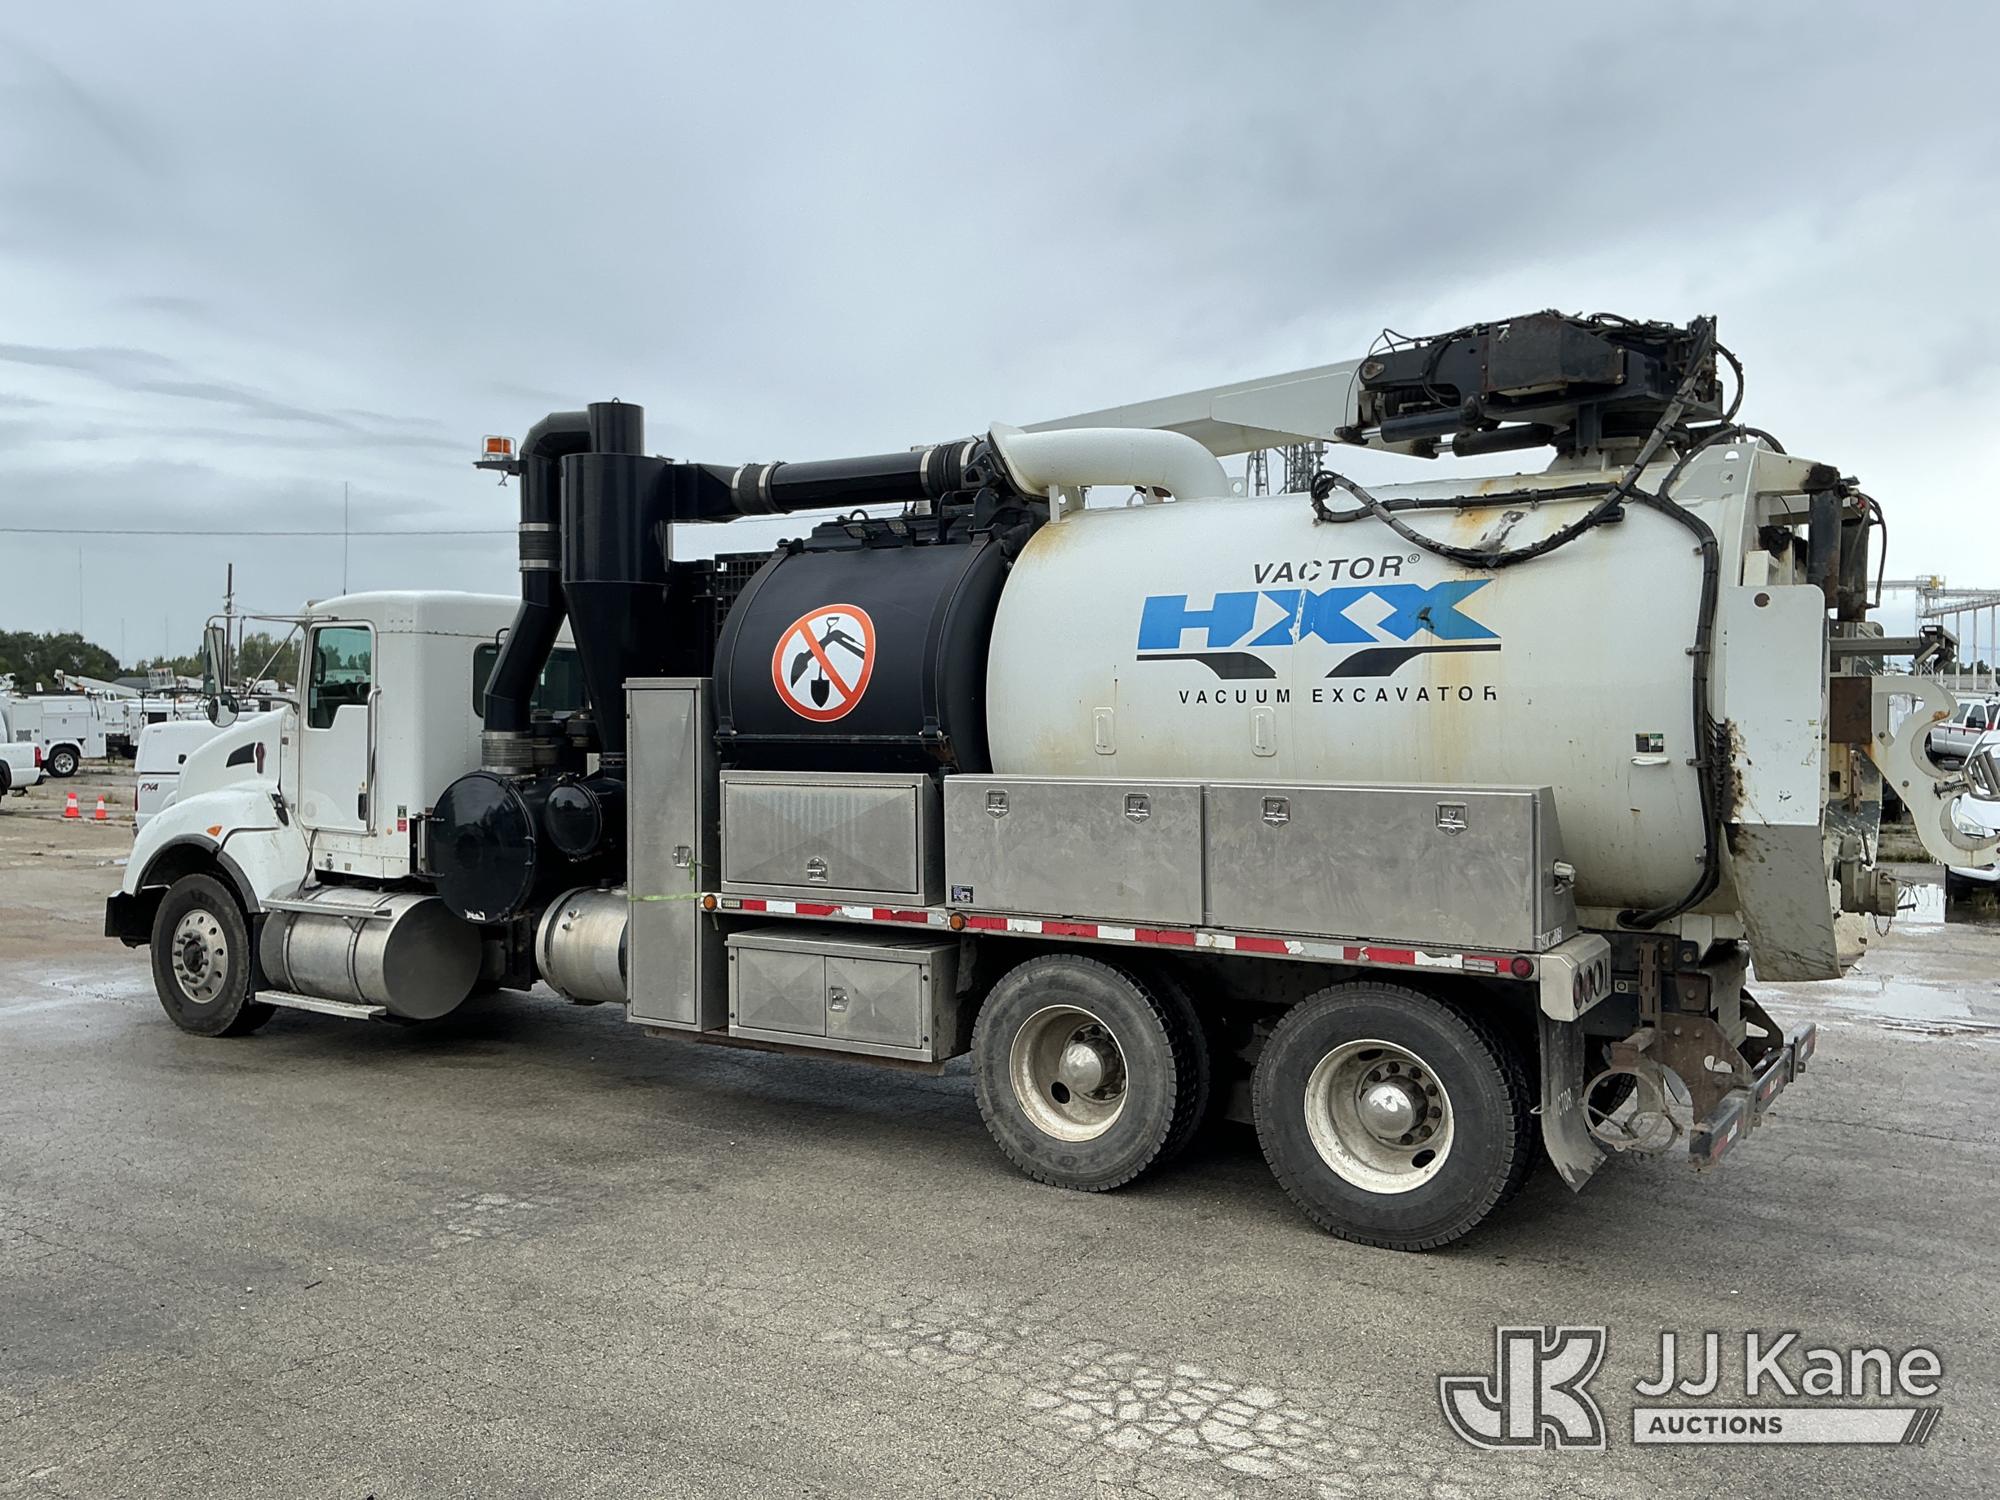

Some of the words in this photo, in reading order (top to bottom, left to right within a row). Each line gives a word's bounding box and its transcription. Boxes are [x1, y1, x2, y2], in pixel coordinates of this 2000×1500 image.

[1178, 687, 1291, 705] VACUUM
[1312, 685, 1498, 704] EXCAVATOR
[140, 782, 159, 792] FX4
